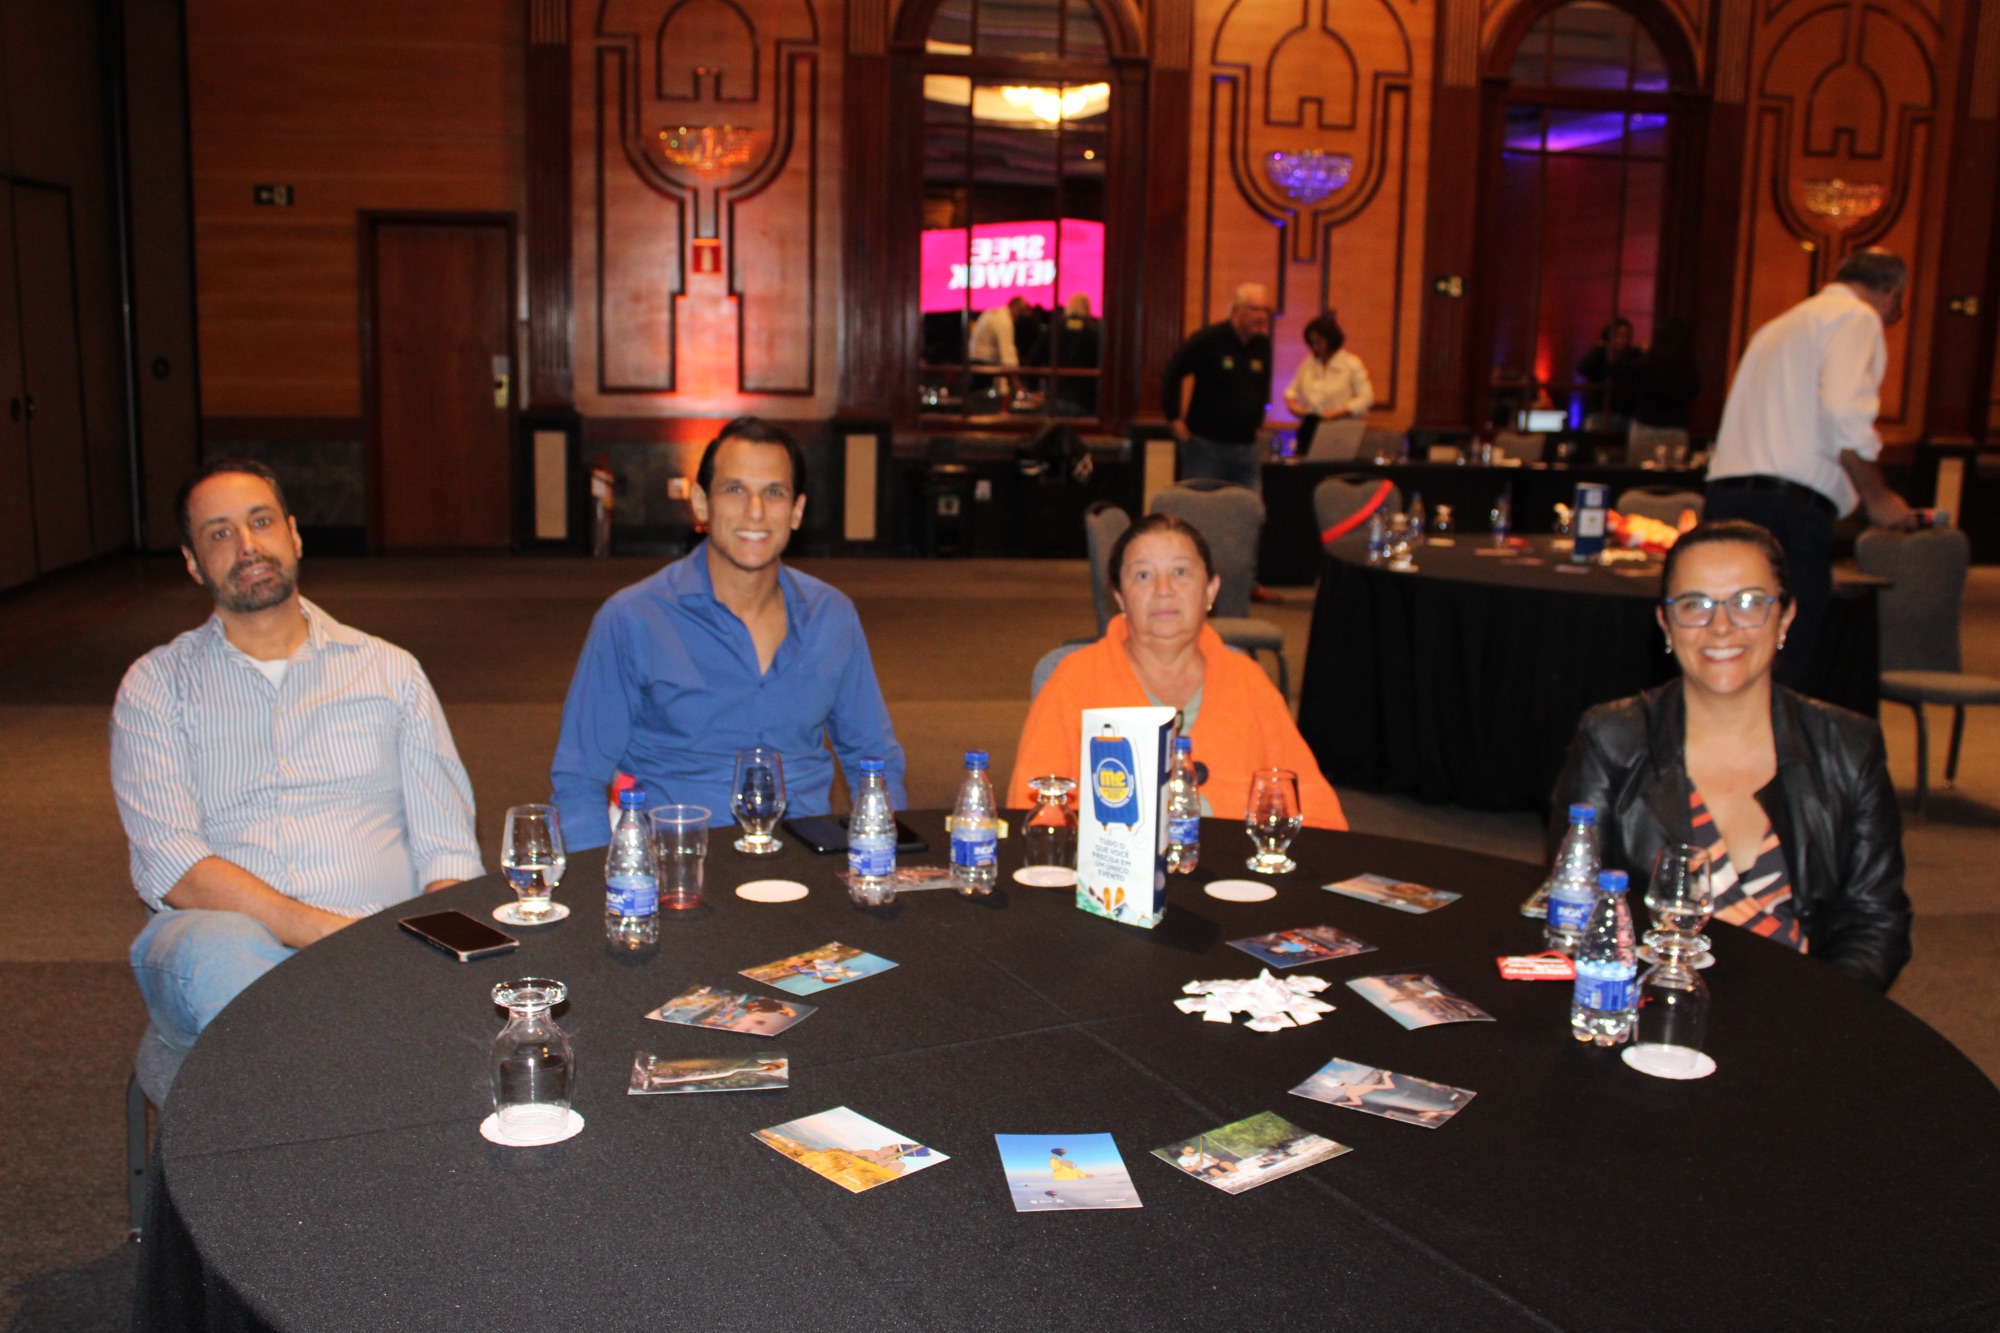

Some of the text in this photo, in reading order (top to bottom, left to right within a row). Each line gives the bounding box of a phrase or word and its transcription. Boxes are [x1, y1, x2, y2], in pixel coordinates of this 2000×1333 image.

[1095, 844, 1109, 853] QUE
[1099, 836, 1126, 850] TUDO O
[1092, 851, 1131, 867] PRECISA EM
[1095, 859, 1106, 868] UM
[1098, 868, 1125, 881] EVENTO
